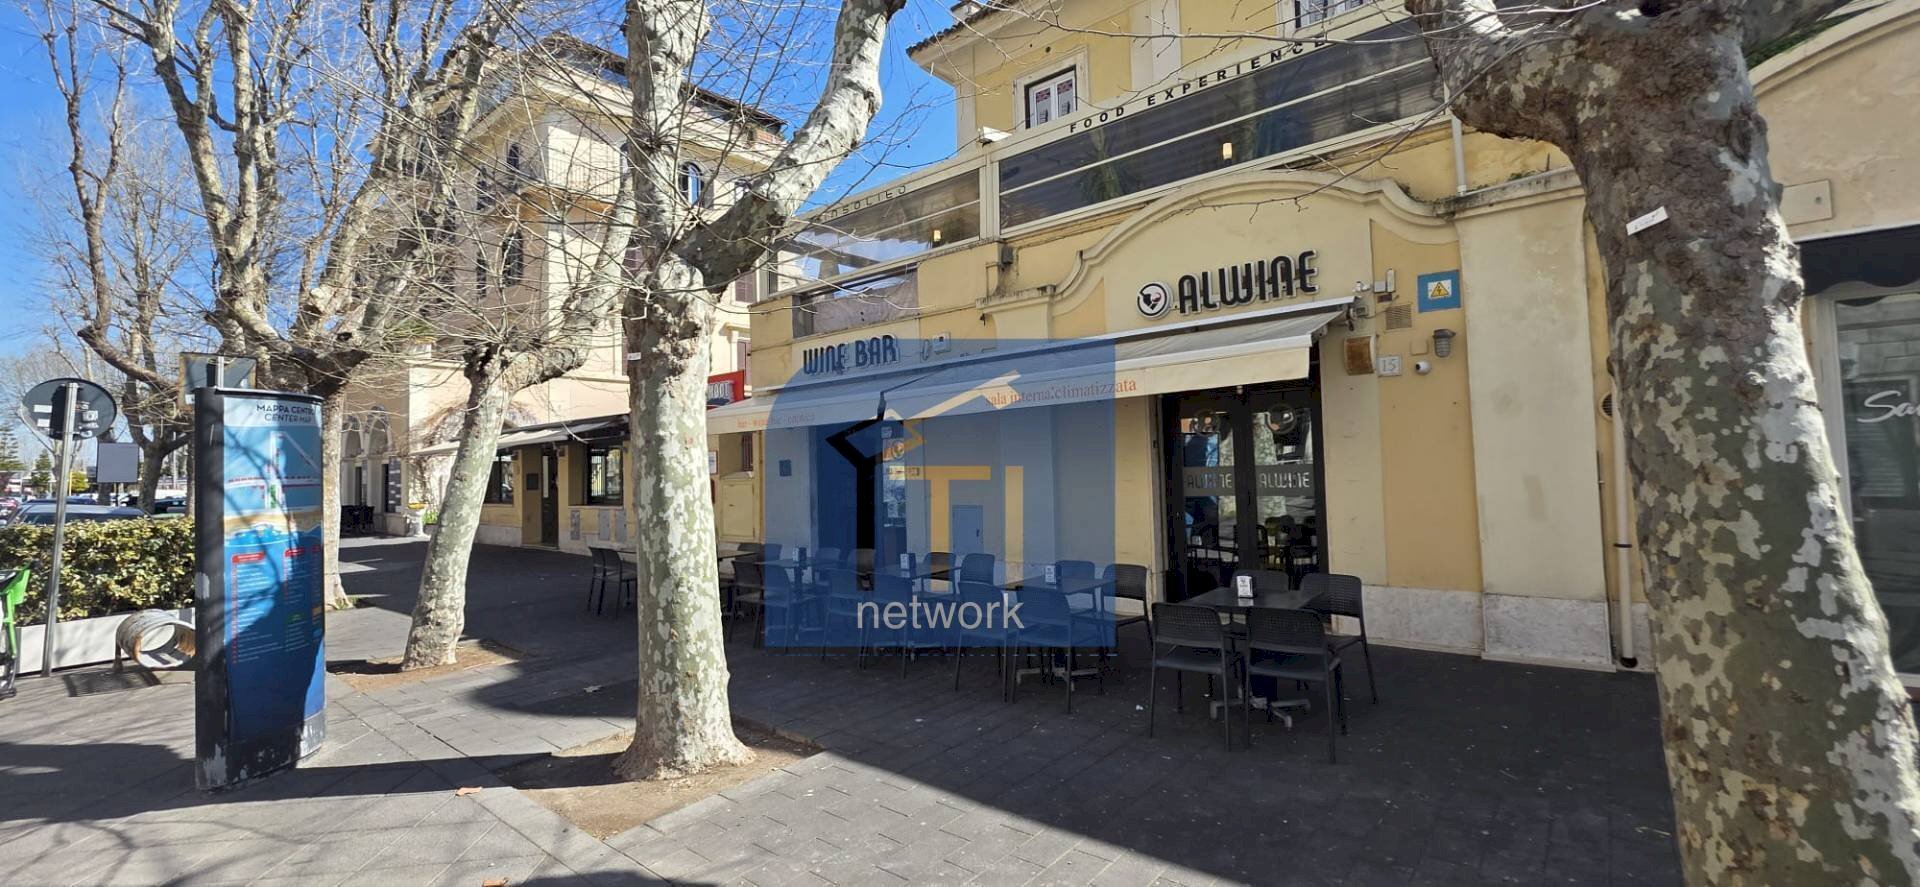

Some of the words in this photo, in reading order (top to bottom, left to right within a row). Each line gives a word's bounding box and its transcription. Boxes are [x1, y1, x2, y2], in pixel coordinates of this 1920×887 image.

[1070, 106, 1125, 133] FOOD
[1147, 33, 1326, 106] EXPERIENCE
[1178, 250, 1317, 314] ALWINE
[803, 343, 846, 375] WINE
[855, 334, 897, 367] BAR
[1381, 358, 1397, 372] 15
[257, 404, 289, 413] MAPPA
[1857, 390, 1920, 423] Sa
